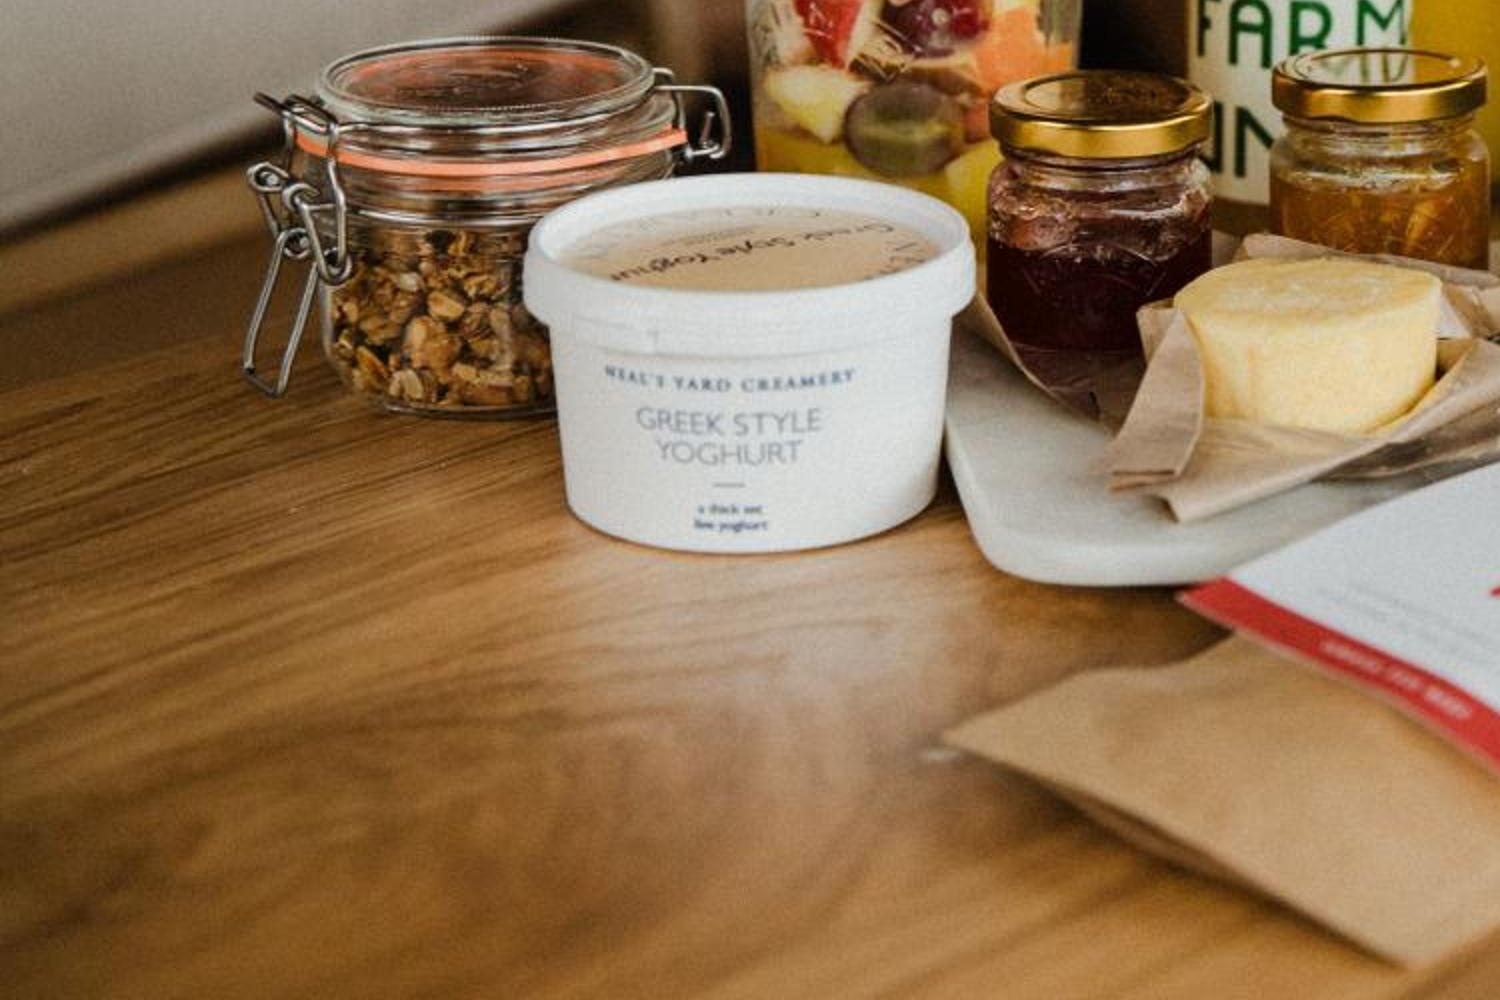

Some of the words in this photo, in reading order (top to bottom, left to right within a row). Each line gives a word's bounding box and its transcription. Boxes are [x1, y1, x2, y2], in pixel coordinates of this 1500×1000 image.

[673, 376, 731, 393] YARD
[740, 368, 855, 393] CREAMERY
[636, 406, 725, 437] GREEK
[732, 407, 822, 437] STYLE
[655, 440, 803, 467] YOGHURT
